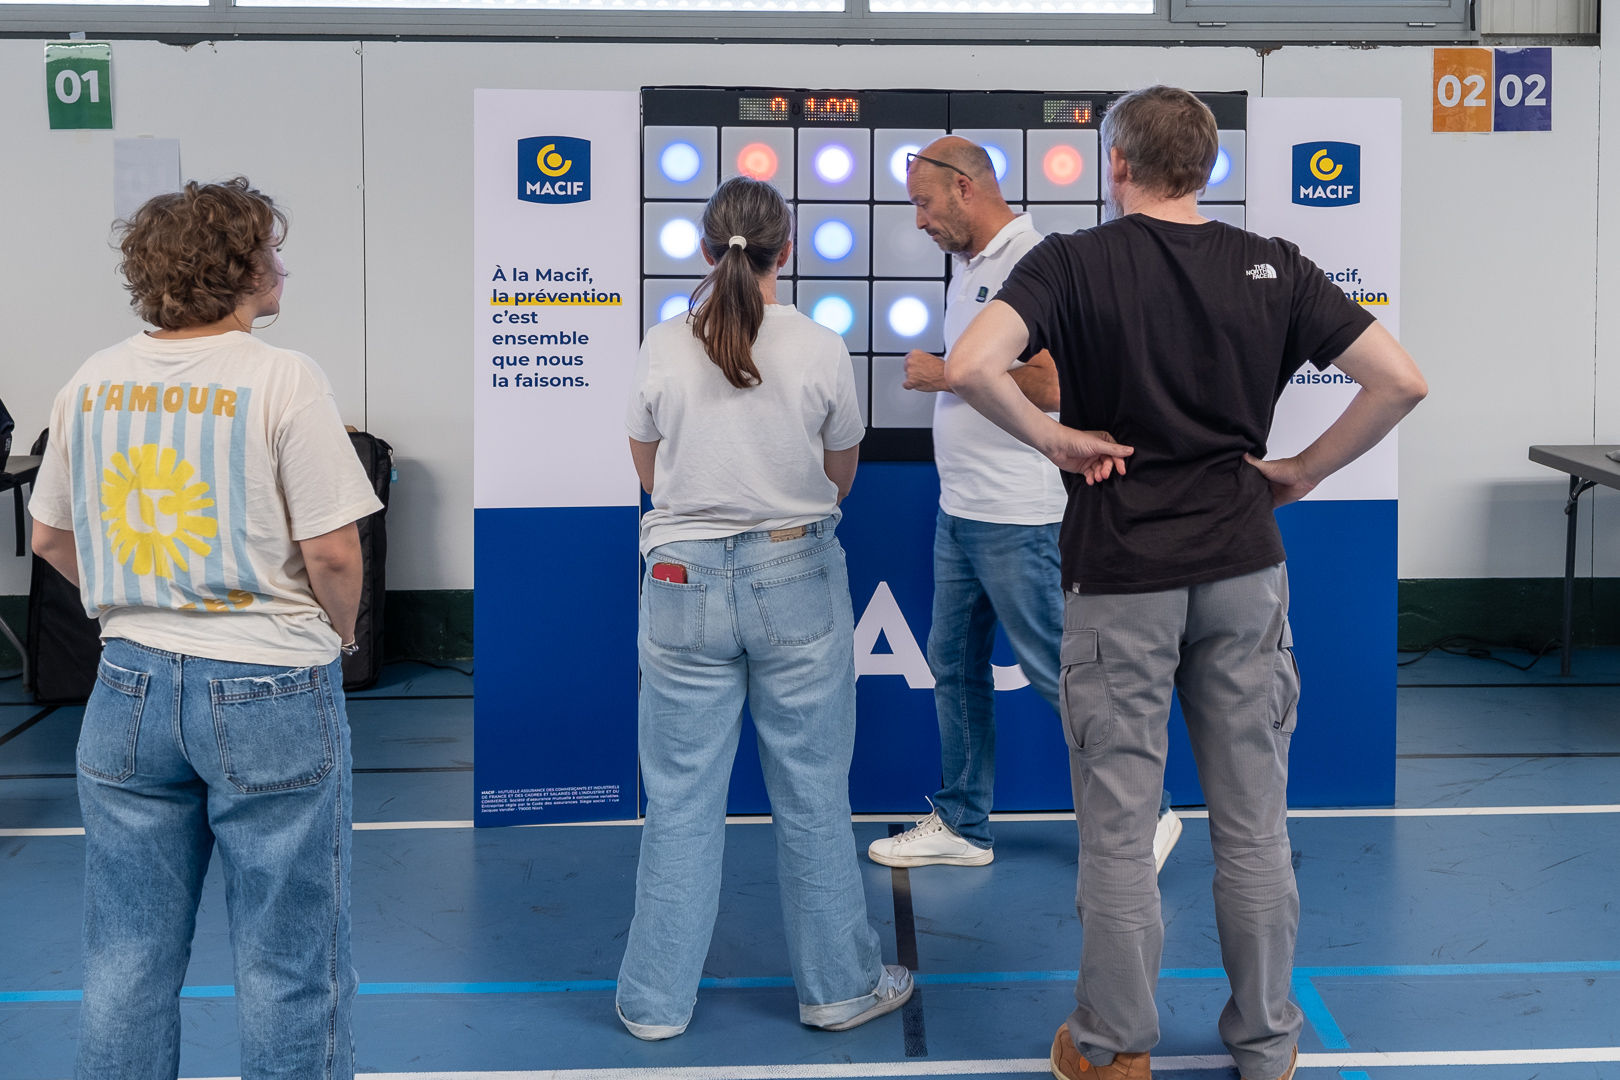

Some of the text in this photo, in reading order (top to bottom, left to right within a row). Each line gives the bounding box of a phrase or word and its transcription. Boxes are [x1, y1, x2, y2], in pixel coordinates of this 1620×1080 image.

[55, 69, 100, 104] 01
[1437, 74, 1487, 108] 02
[1499, 73, 1547, 107] 02
[526, 181, 584, 195] MACIF
[1299, 184, 1354, 199] MACIF
[492, 264, 593, 284] À la Macif,
[1325, 268, 1362, 285] acif,
[492, 288, 621, 306] la prévention
[492, 331, 589, 345] ensemble
[492, 355, 584, 370] que nous
[492, 372, 590, 388] la faisons.
